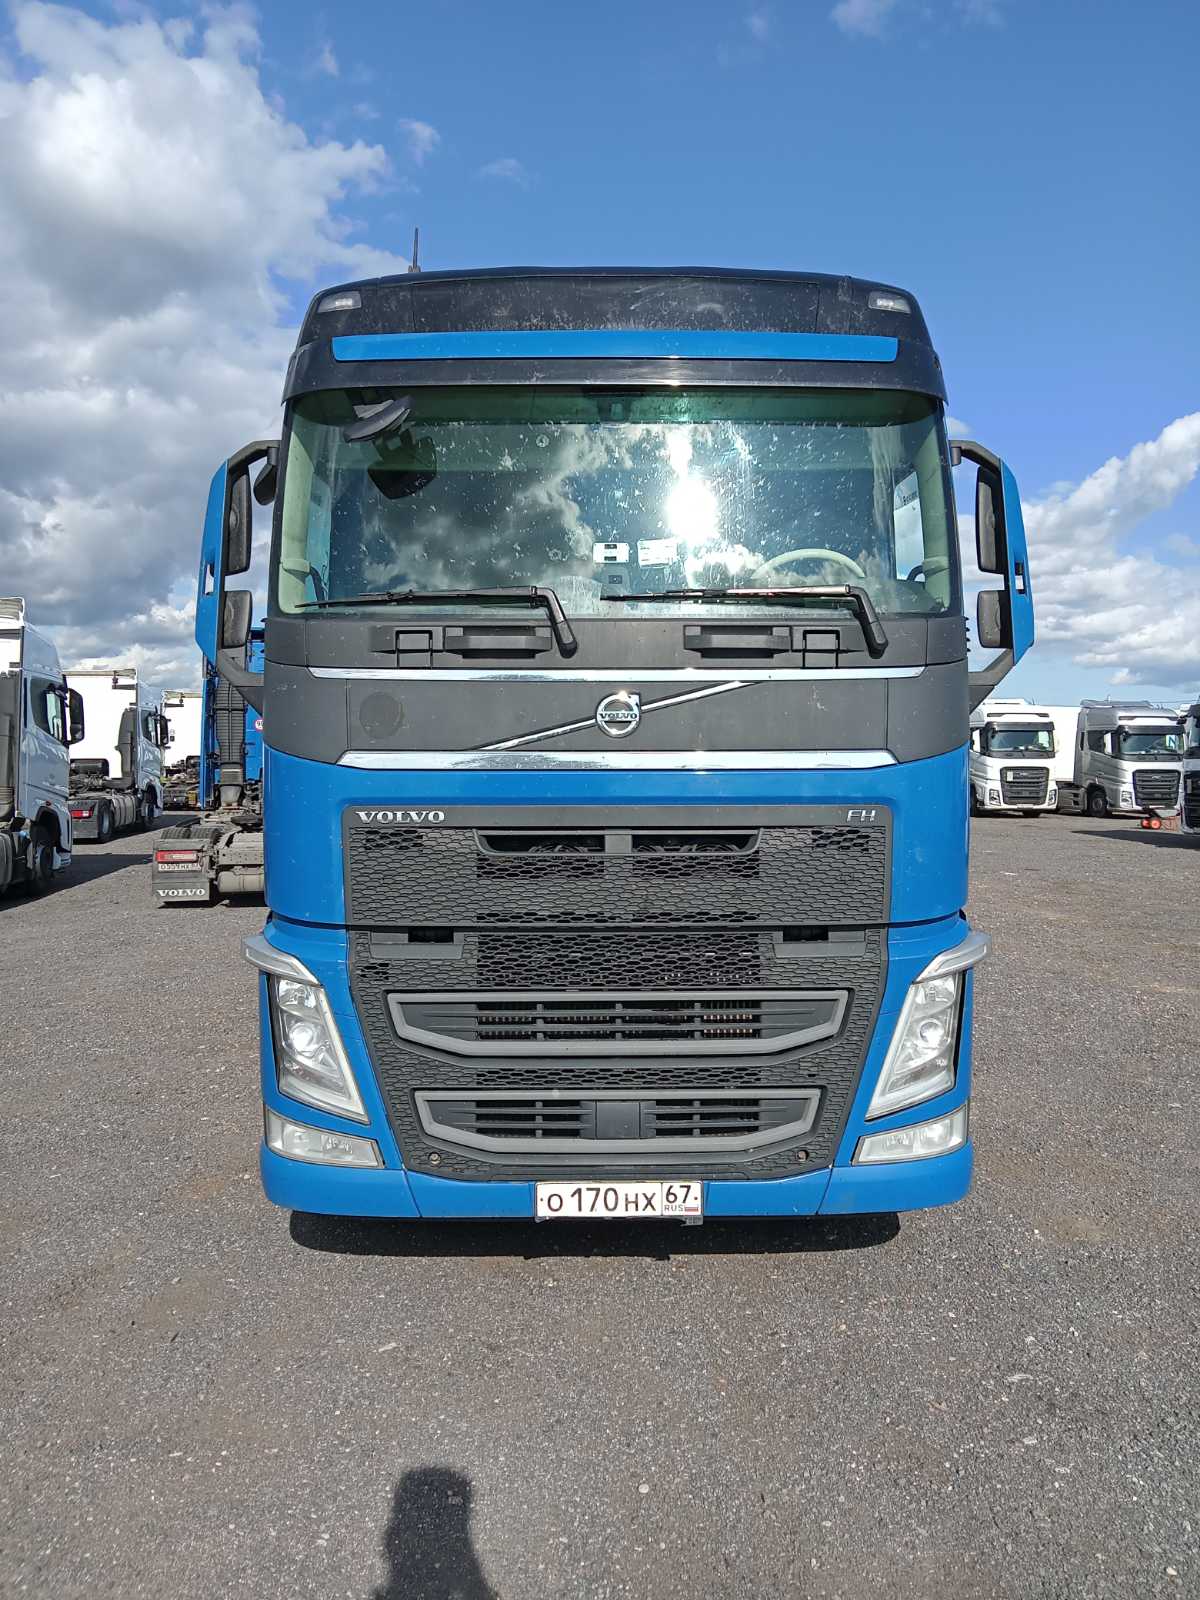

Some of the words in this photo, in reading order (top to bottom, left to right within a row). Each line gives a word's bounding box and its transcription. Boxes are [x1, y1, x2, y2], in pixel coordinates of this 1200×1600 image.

[356, 811, 445, 824] VOLVO
[846, 809, 876, 822] FH
[157, 888, 205, 897] VOLVO
[665, 1185, 691, 1204] 67
[664, 1205, 684, 1213] RUS
